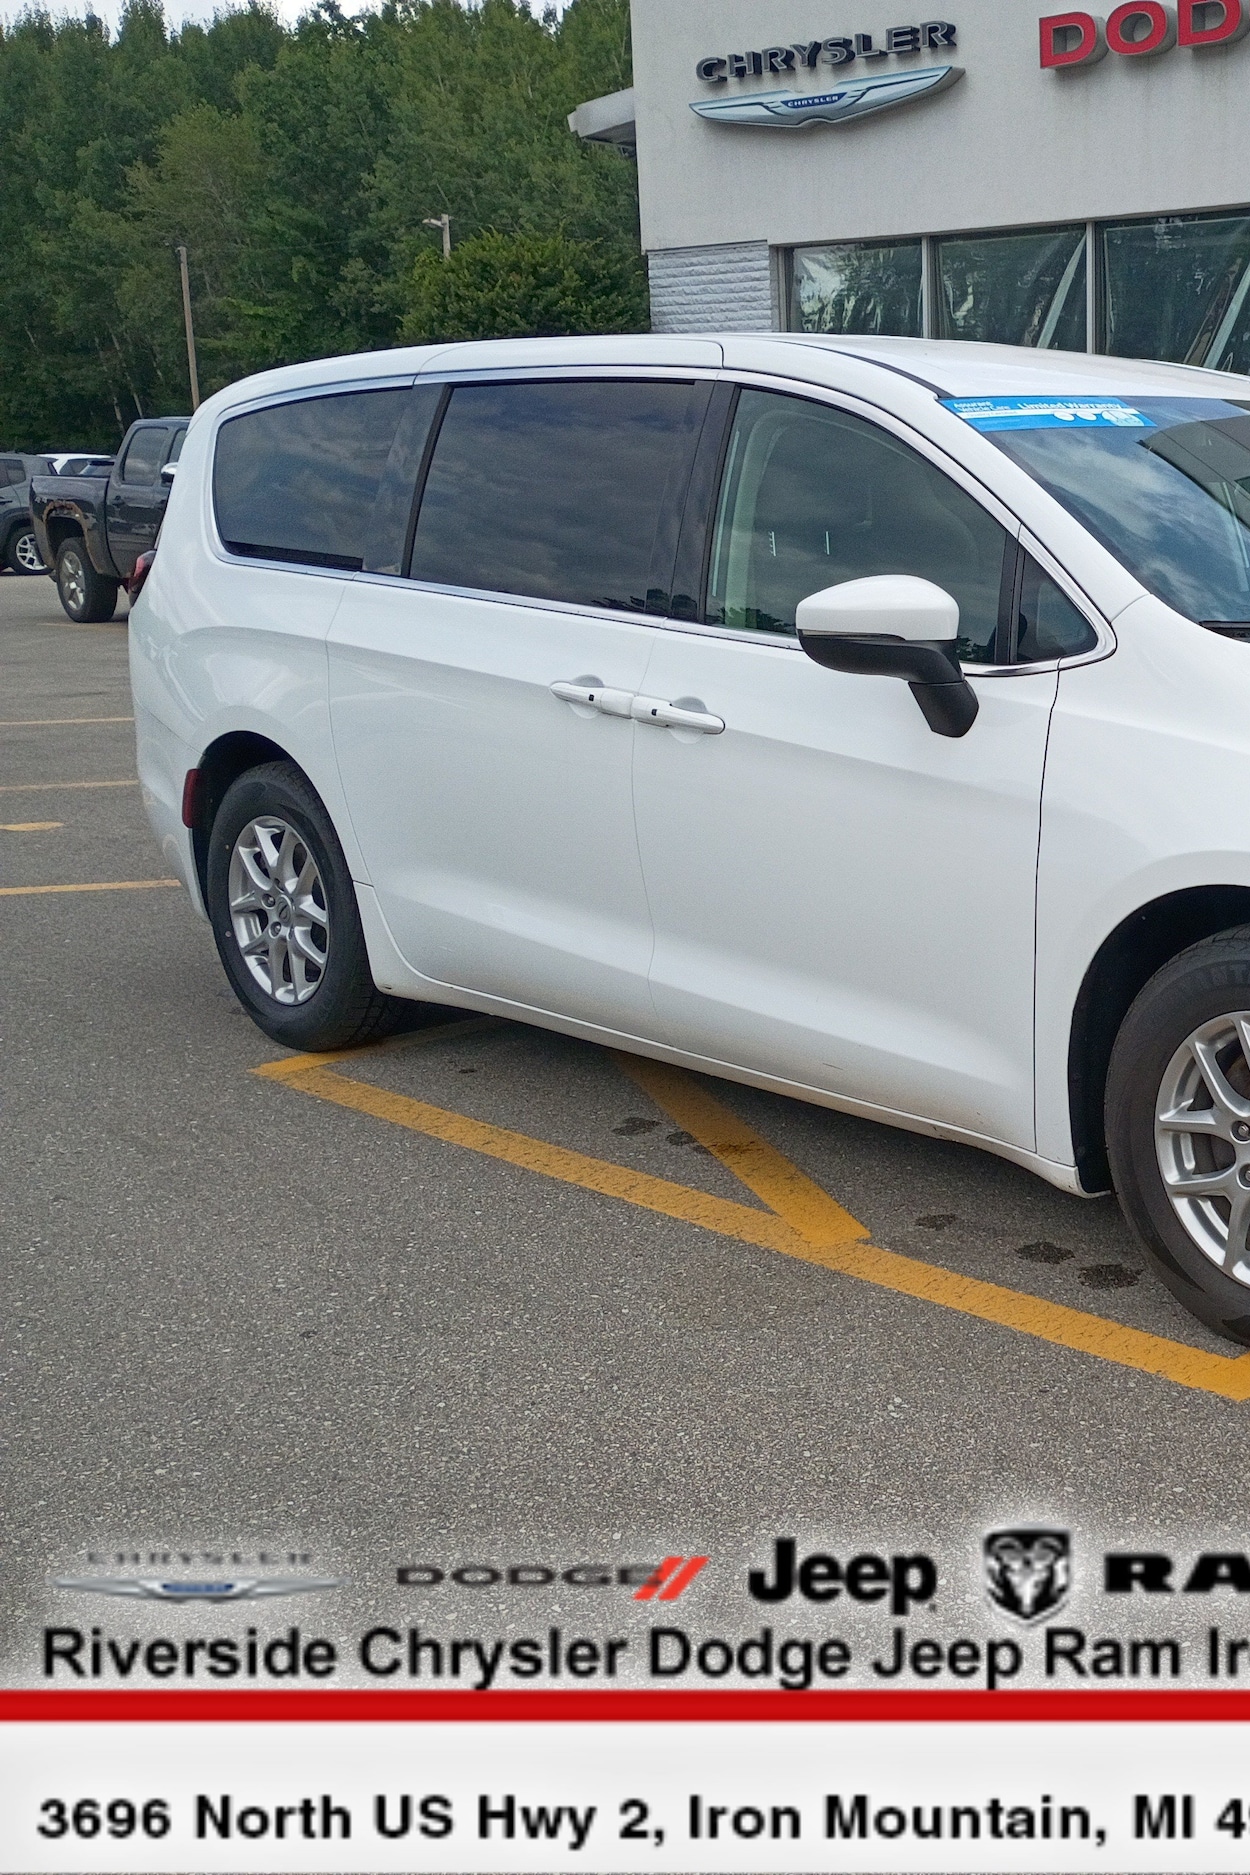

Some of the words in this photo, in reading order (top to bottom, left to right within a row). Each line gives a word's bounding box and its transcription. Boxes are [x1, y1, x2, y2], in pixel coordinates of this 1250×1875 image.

[696, 20, 957, 83] CHRYSLER
[787, 95, 839, 107] CHRYSLER
[1016, 402, 1065, 410] Limited
[1063, 402, 1122, 410] Warranty
